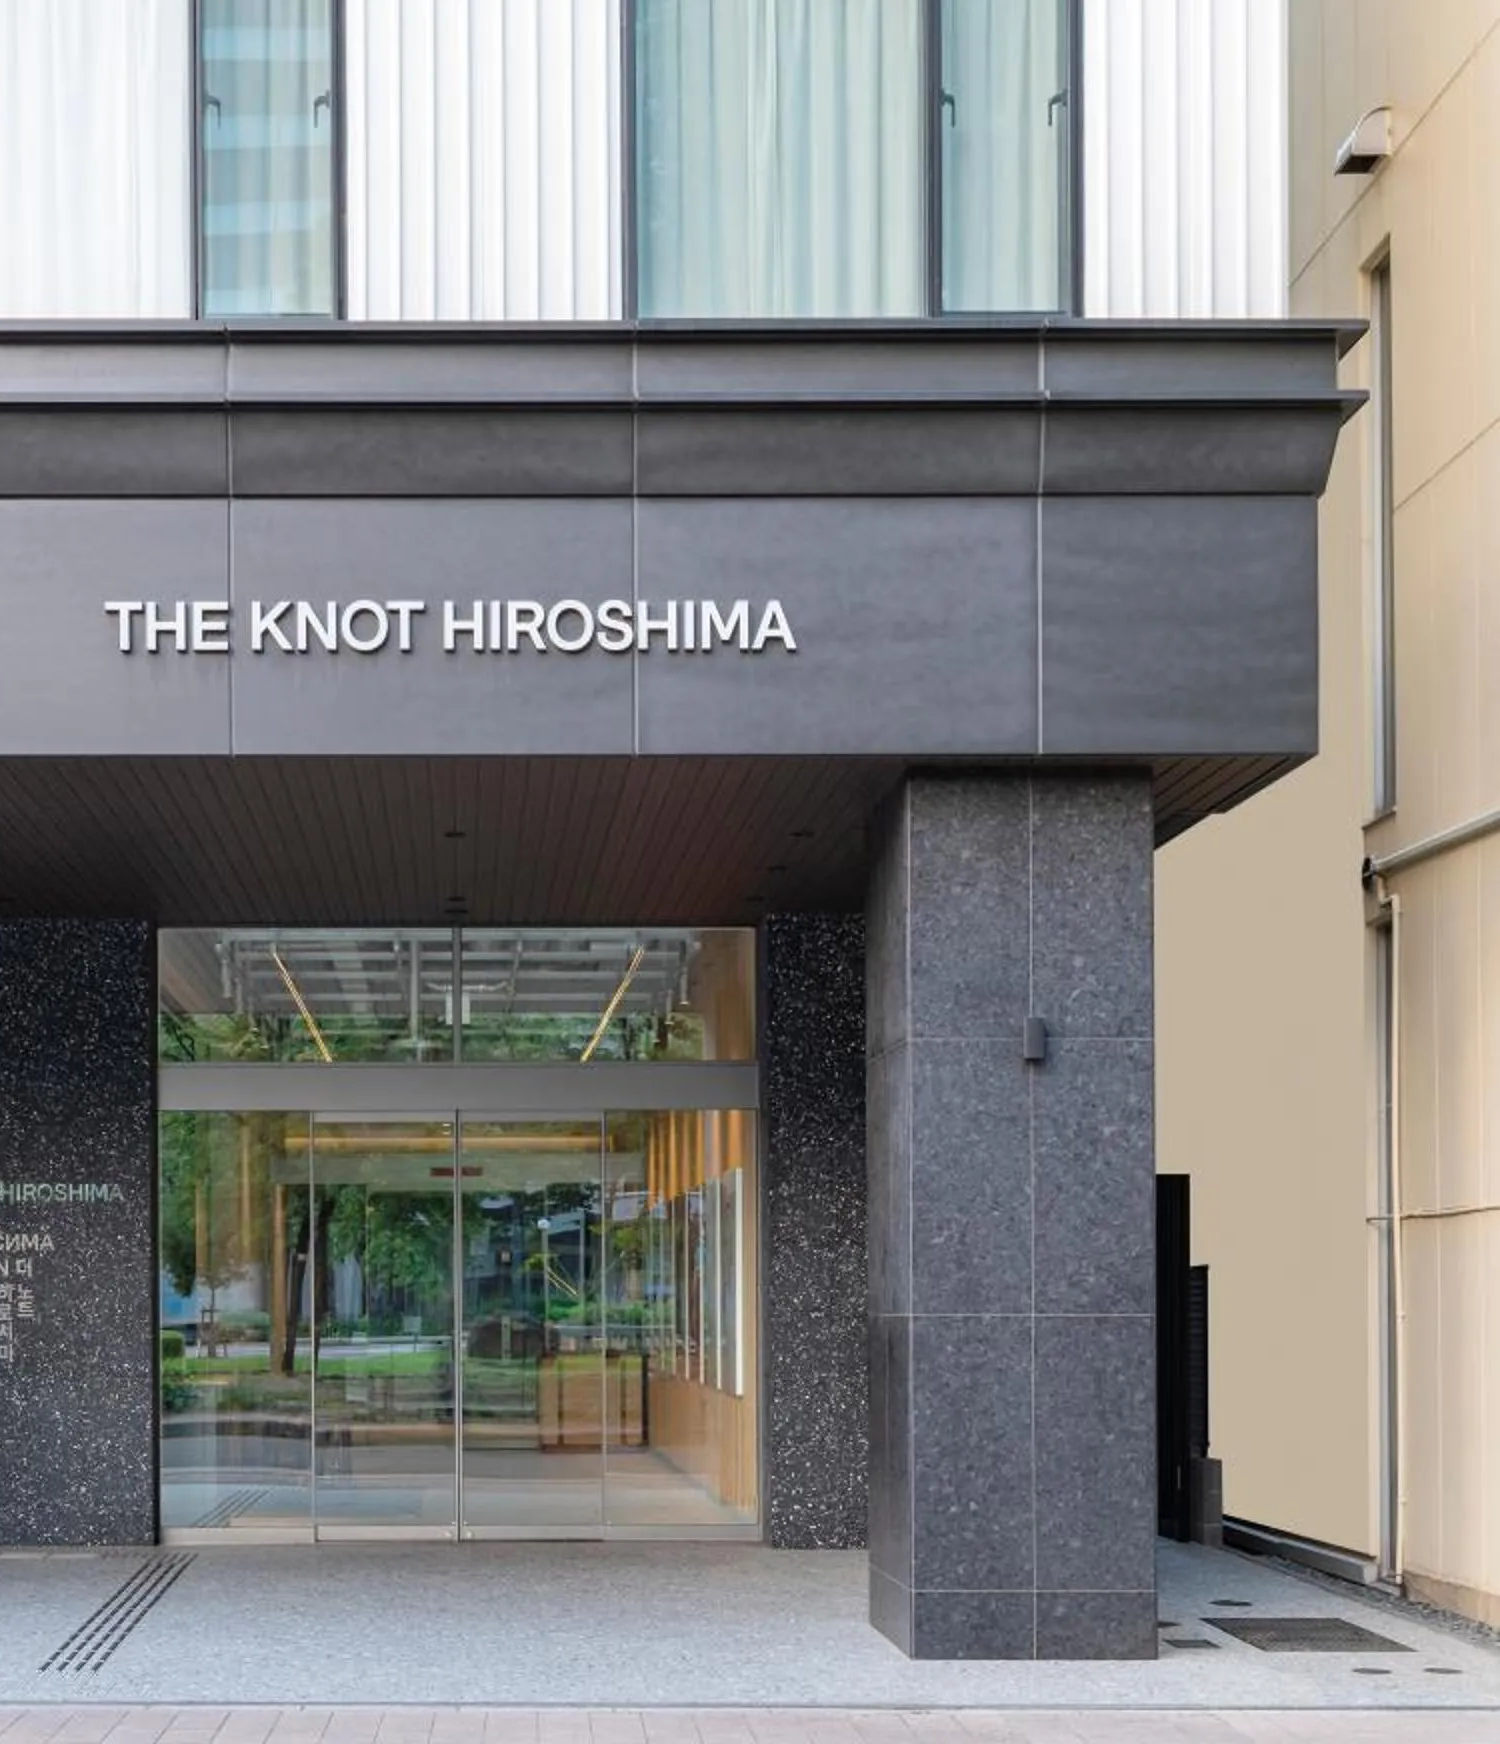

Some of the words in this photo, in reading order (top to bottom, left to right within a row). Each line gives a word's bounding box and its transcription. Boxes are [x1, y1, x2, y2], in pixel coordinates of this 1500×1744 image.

[105, 600, 229, 652] THE
[250, 600, 425, 652] KNOT
[442, 600, 797, 652] HIROSHIMA
[0, 1183, 125, 1202] HIROSHIMA
